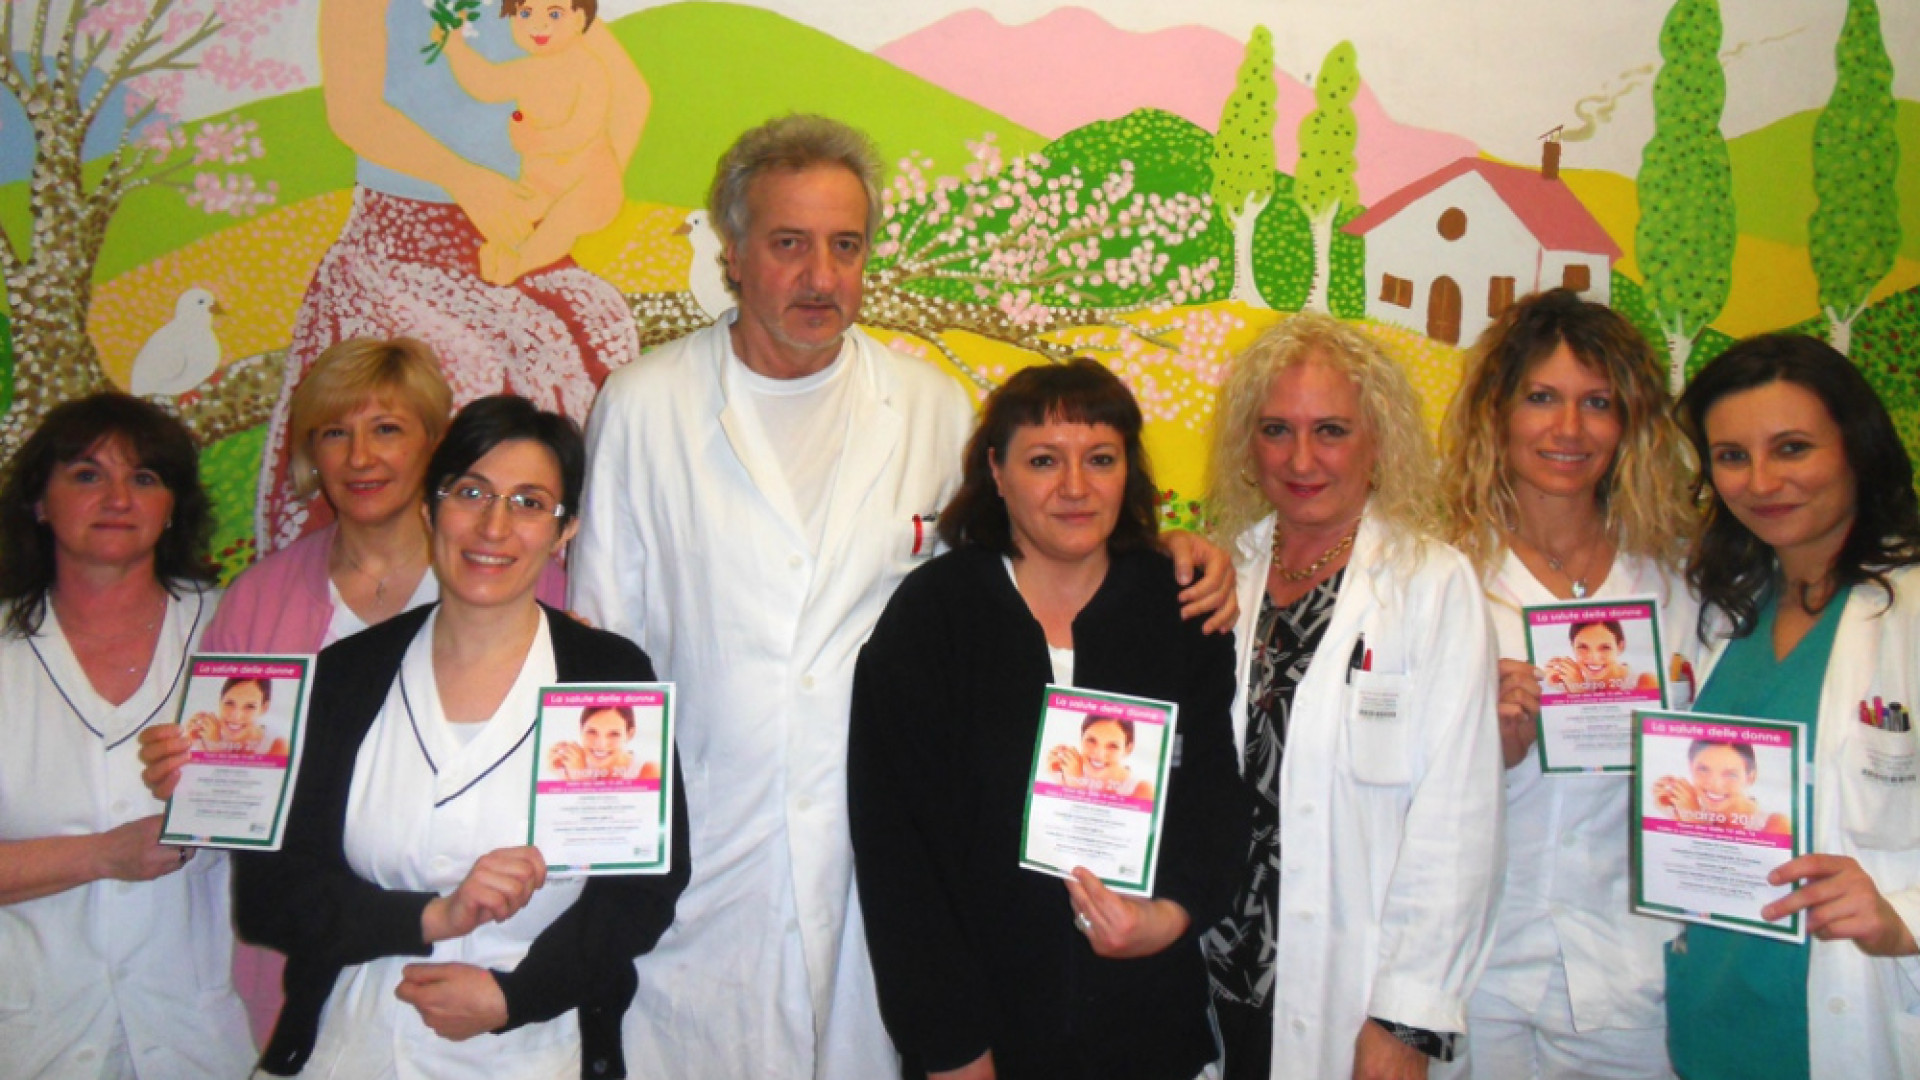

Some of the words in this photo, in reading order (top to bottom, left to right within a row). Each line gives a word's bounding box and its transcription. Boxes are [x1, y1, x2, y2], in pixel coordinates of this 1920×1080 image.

[1536, 613, 1548, 622] La
[1551, 609, 1579, 620] salute
[1582, 608, 1606, 619] delle
[1609, 608, 1643, 616] donne
[200, 663, 210, 673] La
[212, 664, 237, 674] salute
[240, 664, 263, 674] delle
[265, 665, 295, 676] donne
[551, 693, 562, 703] La
[566, 694, 593, 703] salute
[597, 693, 620, 703] delle
[624, 693, 656, 703] donne
[1055, 697, 1066, 707] La
[1069, 700, 1097, 711] salute
[1101, 703, 1124, 715] delle
[1126, 706, 1158, 720] donne
[1652, 722, 1665, 732] La
[1669, 723, 1703, 736] salute
[1708, 727, 1737, 740] delle
[1741, 730, 1781, 743] donne
